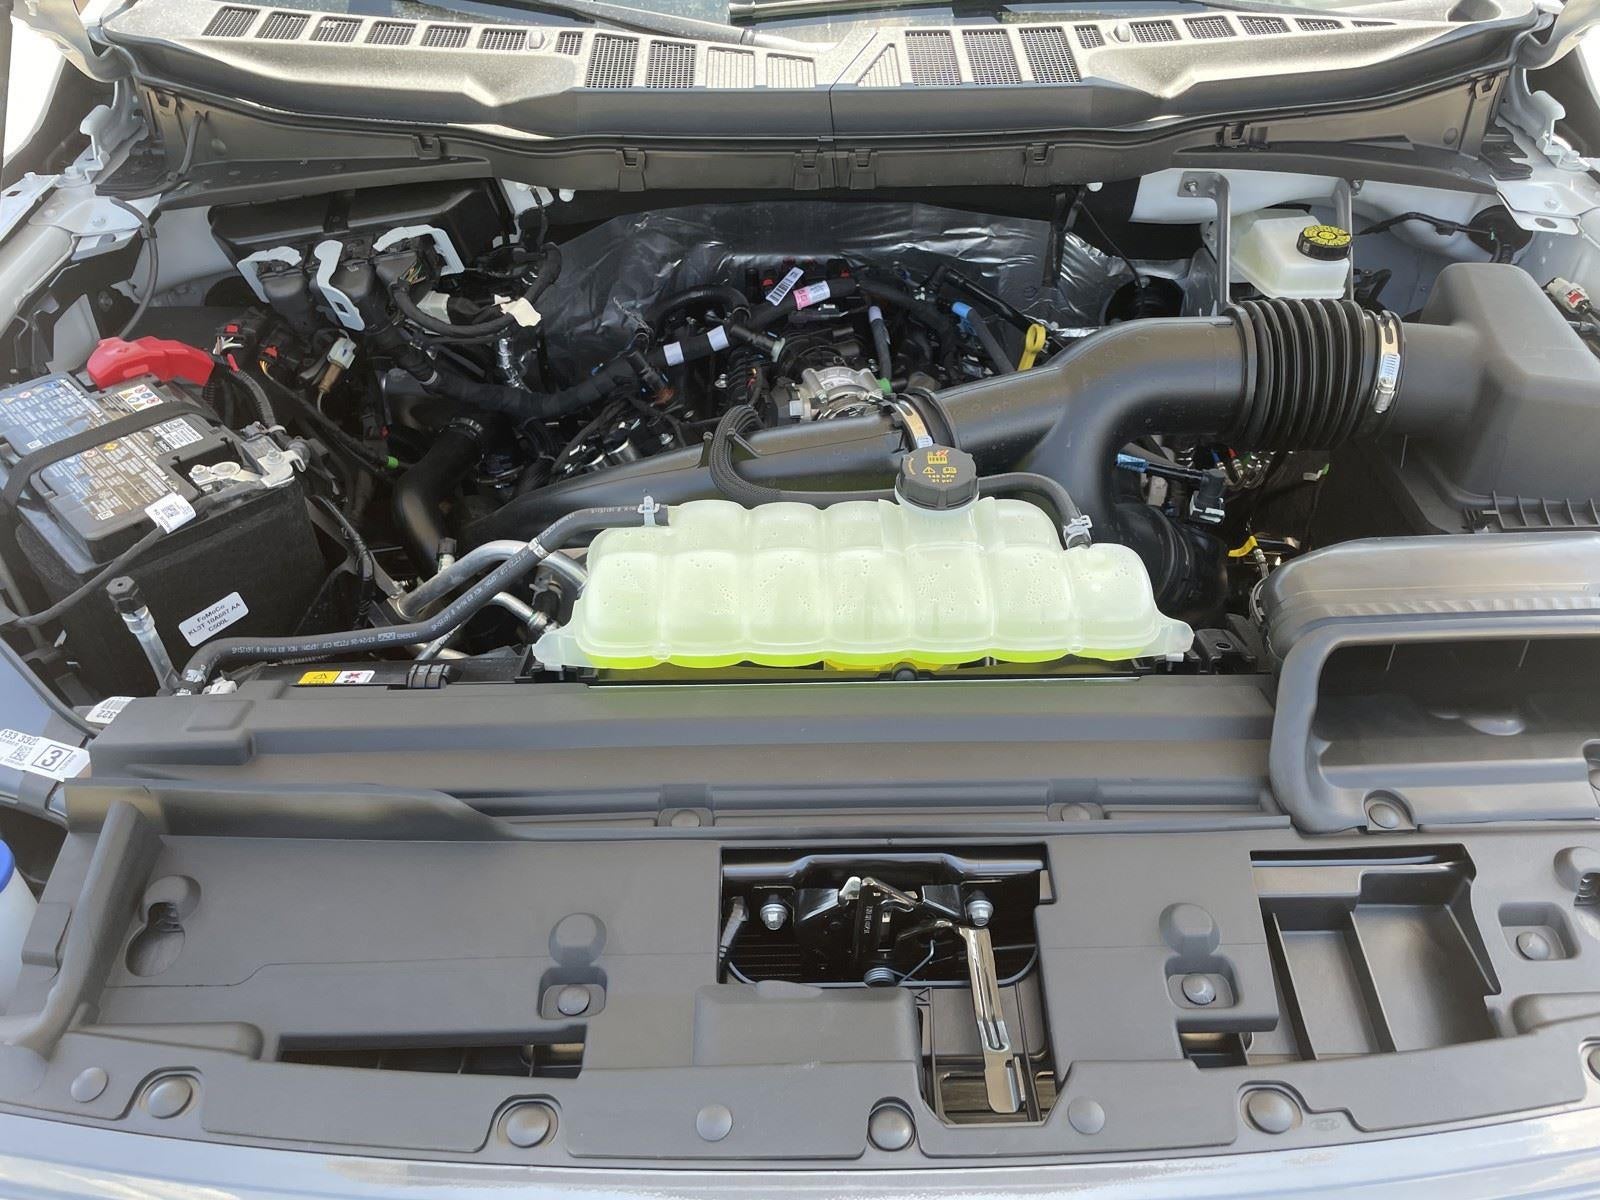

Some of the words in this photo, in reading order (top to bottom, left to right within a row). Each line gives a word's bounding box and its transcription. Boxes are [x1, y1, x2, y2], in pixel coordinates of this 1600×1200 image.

[197, 604, 225, 622] FoMoCo
[231, 602, 241, 610] AA
[41, 749, 63, 767] 3
